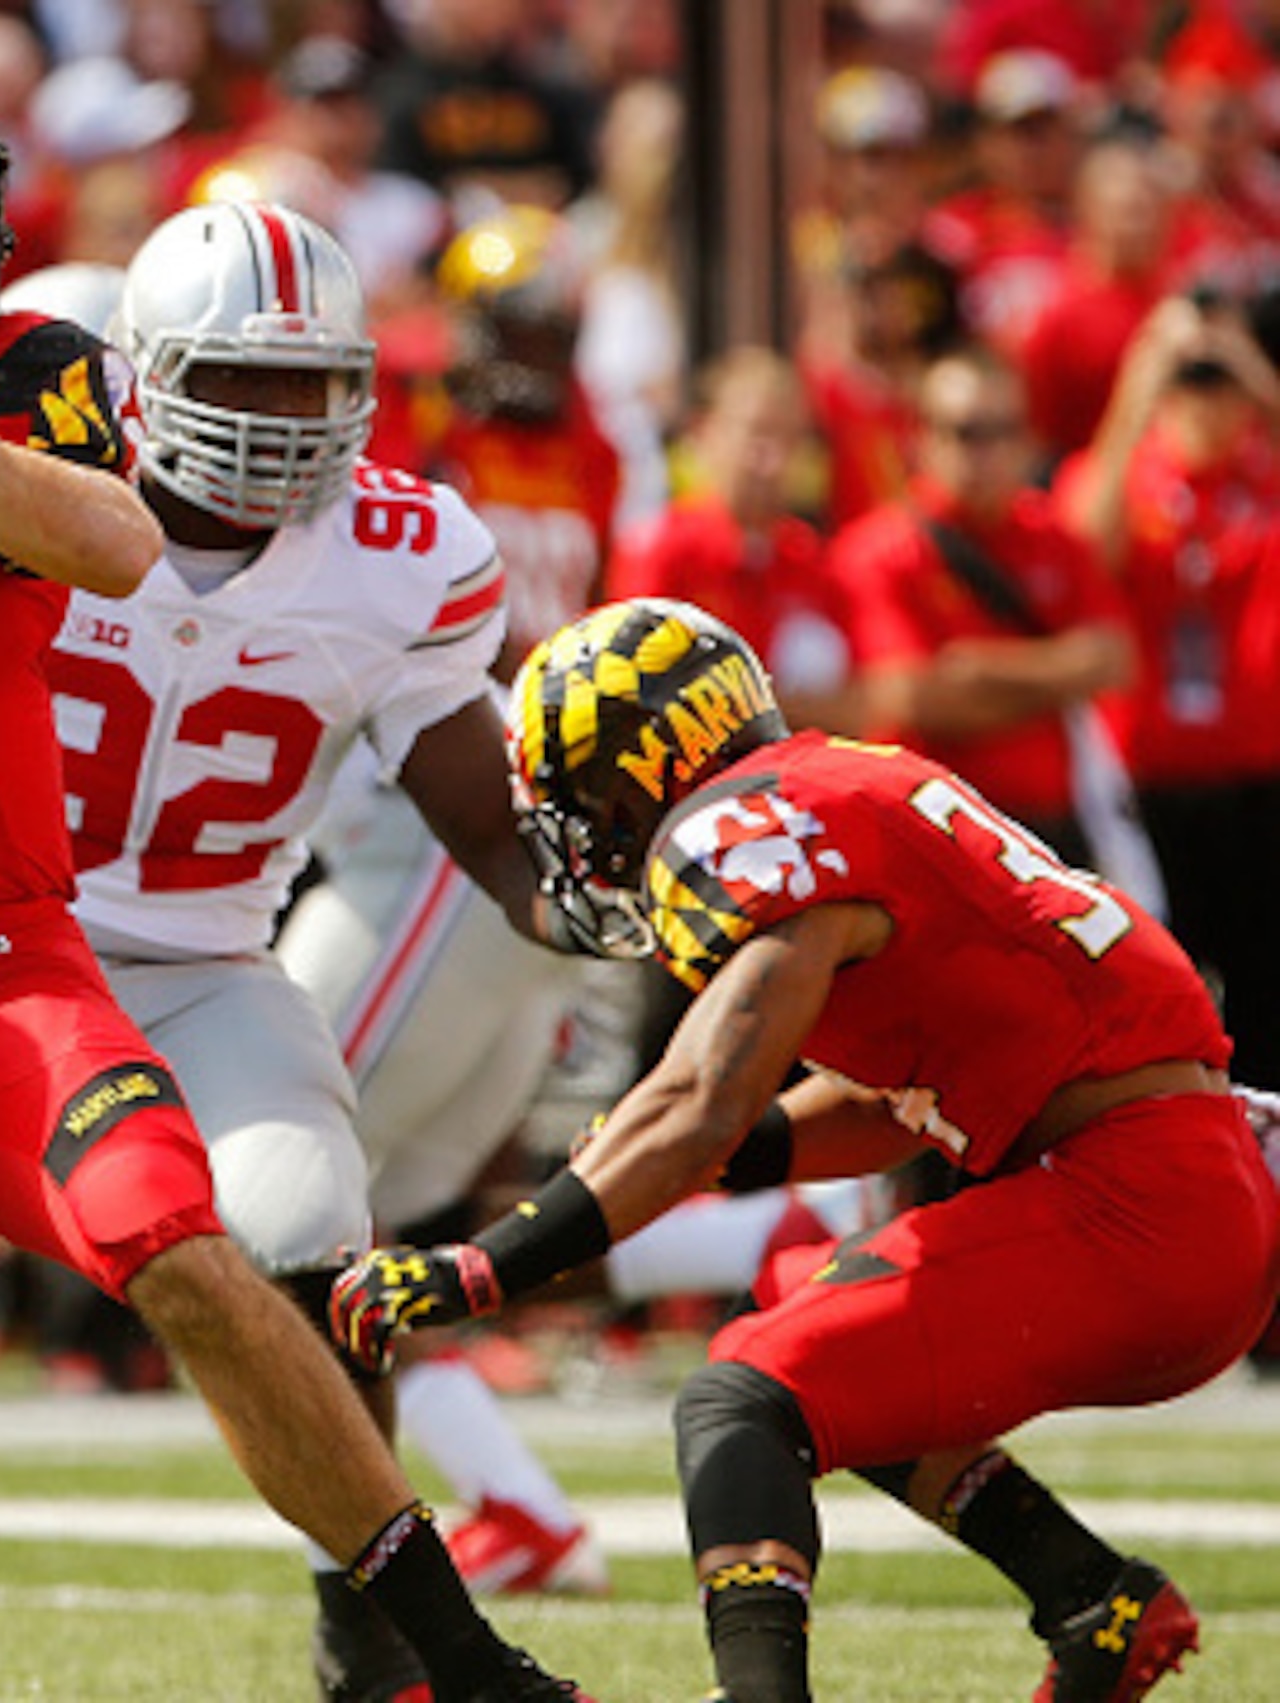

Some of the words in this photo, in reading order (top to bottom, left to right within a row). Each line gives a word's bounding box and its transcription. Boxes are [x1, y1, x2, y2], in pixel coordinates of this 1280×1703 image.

[352, 464, 438, 557] 92
[48, 648, 326, 893] 92
[63, 1071, 160, 1138] MARYLAND
